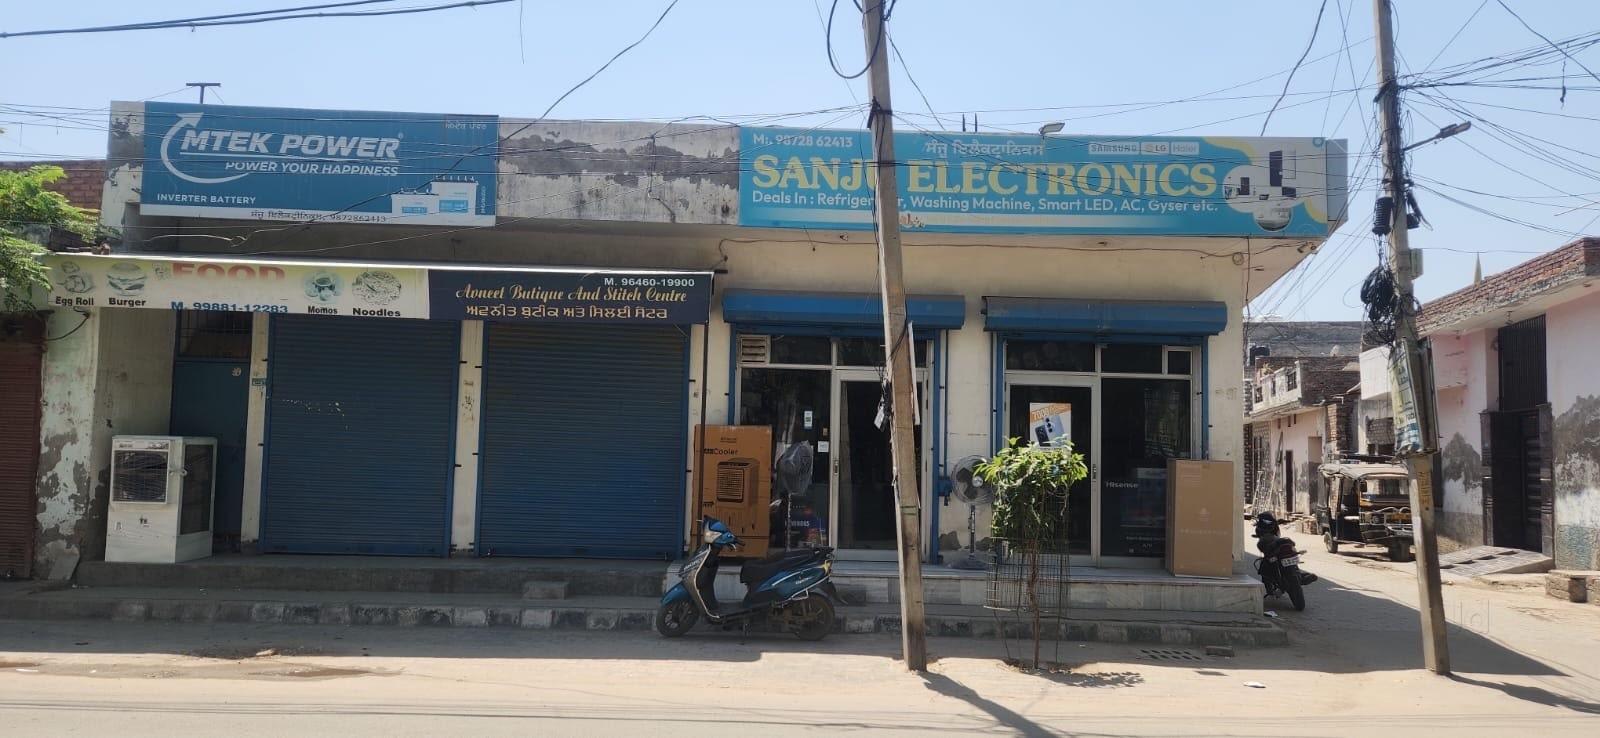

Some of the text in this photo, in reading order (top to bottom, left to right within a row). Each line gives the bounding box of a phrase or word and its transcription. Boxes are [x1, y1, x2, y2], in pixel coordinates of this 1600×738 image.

[181, 129, 400, 158] MTEK POWER
[775, 133, 813, 147] 98728
[816, 136, 853, 148] 62413
[1155, 144, 1167, 152] LG
[225, 161, 399, 176] POWER YOUR HAPPINESS
[907, 160, 1217, 197] ELECTRONICS
[157, 193, 256, 205] INVERTER BATTERY
[752, 190, 792, 205] Deals
[794, 191, 806, 205] In
[910, 196, 968, 211] Washing
[972, 197, 1034, 211] Machine,
[1039, 199, 1081, 211] Smart
[1084, 199, 1117, 213] LED,
[1121, 200, 1144, 214] AC,
[1149, 200, 1189, 214] Gyser
[1192, 201, 1218, 212] etc.
[604, 278, 695, 287] M. 96460-19900
[455, 283, 687, 303] Avneet Butique And Stitch Centre
[56, 296, 94, 307] Egg Roll
[108, 297, 146, 308] Burger
[193, 302, 288, 313] 99881-12283
[307, 306, 337, 315] Momos
[353, 307, 401, 318] Noodles
